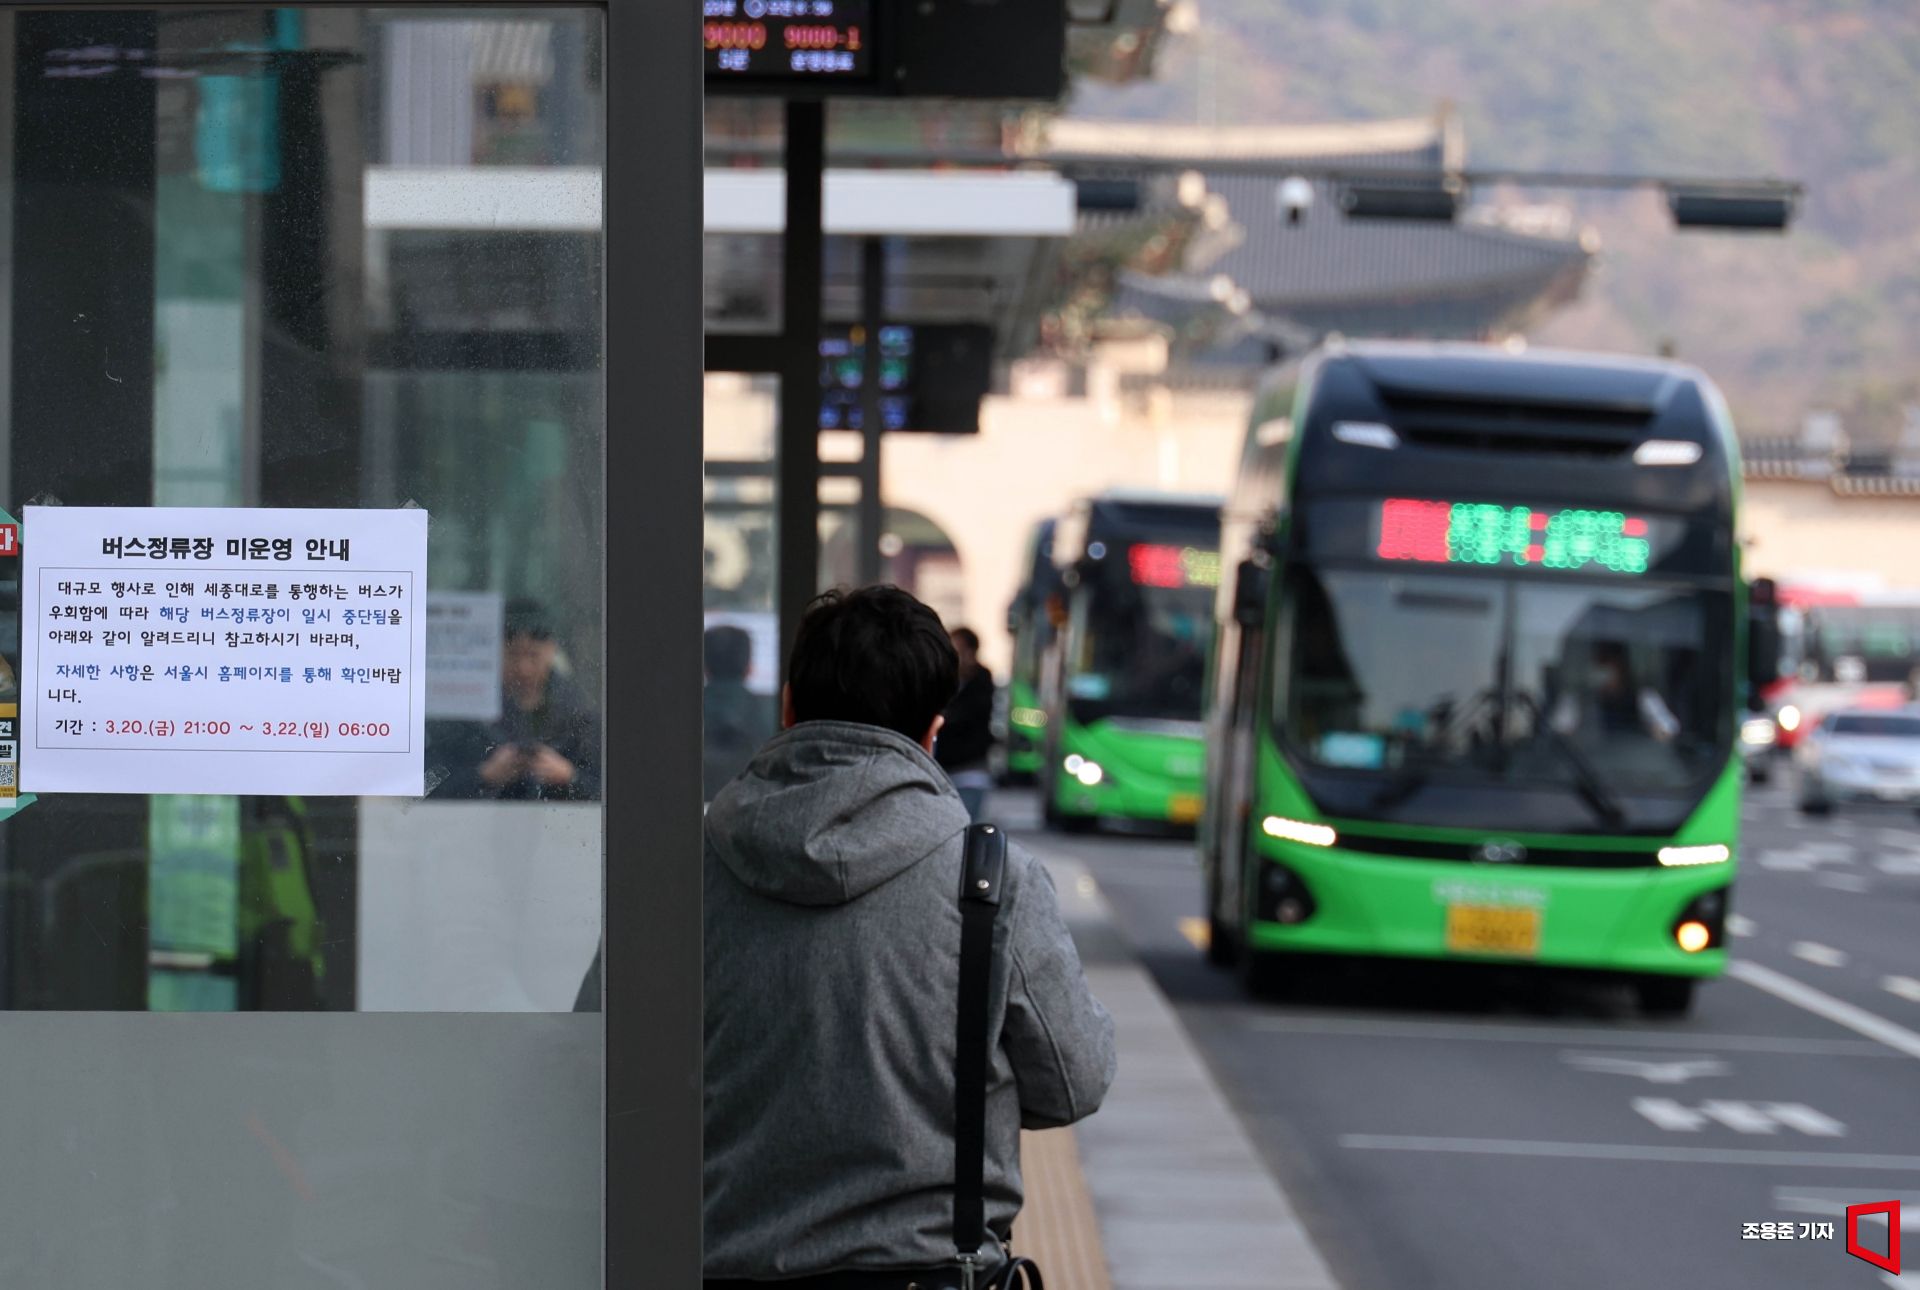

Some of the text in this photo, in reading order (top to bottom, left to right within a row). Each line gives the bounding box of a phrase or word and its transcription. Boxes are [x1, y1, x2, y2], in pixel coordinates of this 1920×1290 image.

[102, 535, 350, 562] 버스정류장 미운영 안내
[57, 580, 404, 601] 대규모 행사로 인해 세종대로를 통행하는 버스가
[48, 604, 403, 626] 우회함에 따라 해당 버스정류장이 일시 중단됨을
[48, 629, 360, 650] 아래와 같이 알려드리니 참고하시기 바라며,
[55, 663, 402, 684] 자세한 사항은 서울시 홈페이지를 통해 확인바랍
[48, 688, 82, 704] 니다.
[55, 718, 84, 736] 기간
[105, 719, 175, 737] 3.20.(금)
[183, 720, 231, 735] 21:00
[262, 721, 330, 739] 3.22.(일)
[338, 722, 390, 737] 06:00
